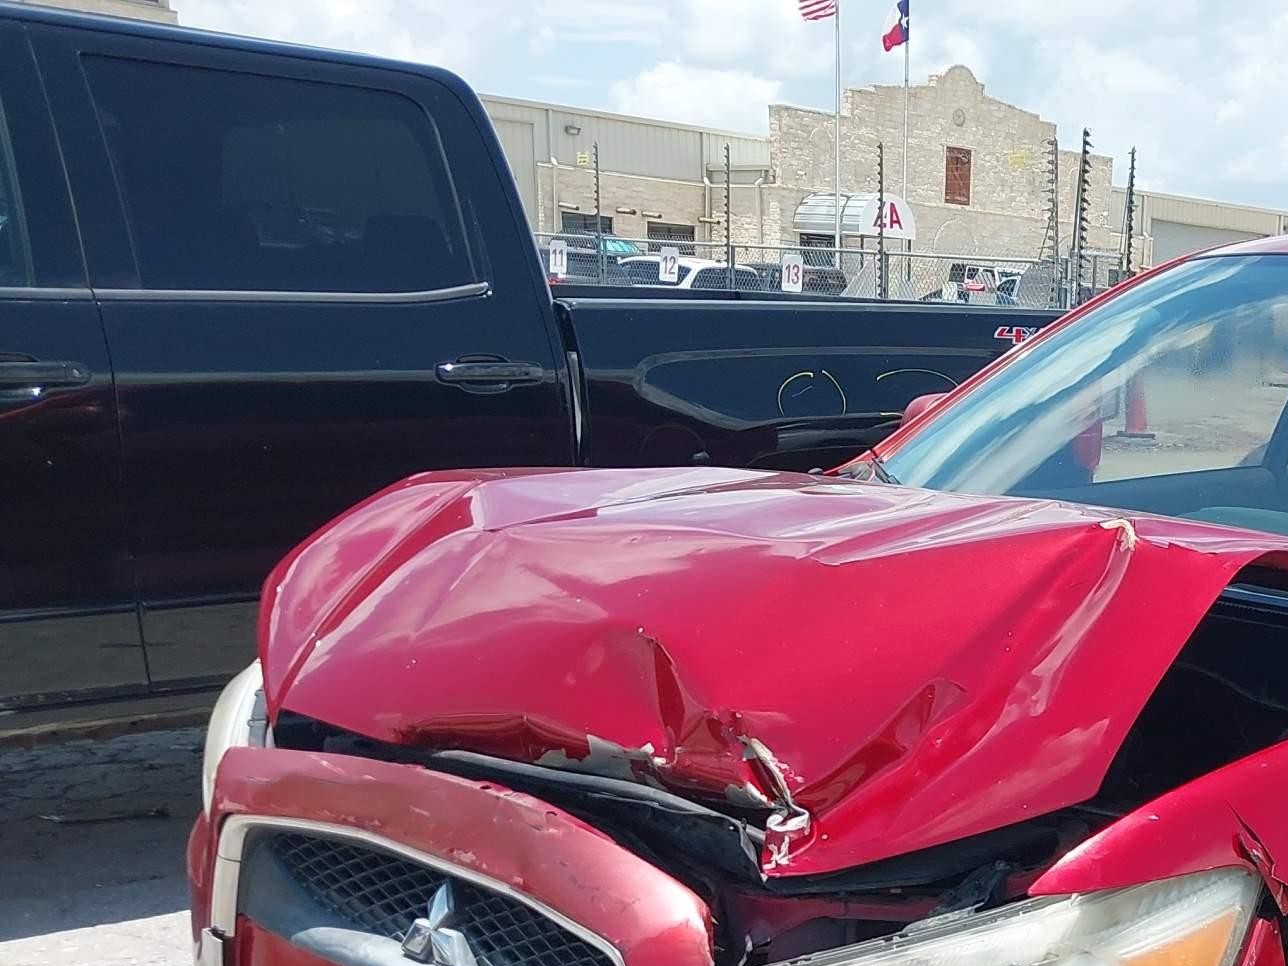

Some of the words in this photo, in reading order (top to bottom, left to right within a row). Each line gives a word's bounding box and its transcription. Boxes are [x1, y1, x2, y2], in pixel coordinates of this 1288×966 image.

[552, 248, 564, 267] 11
[662, 255, 676, 275] 12
[785, 264, 800, 284] 13
